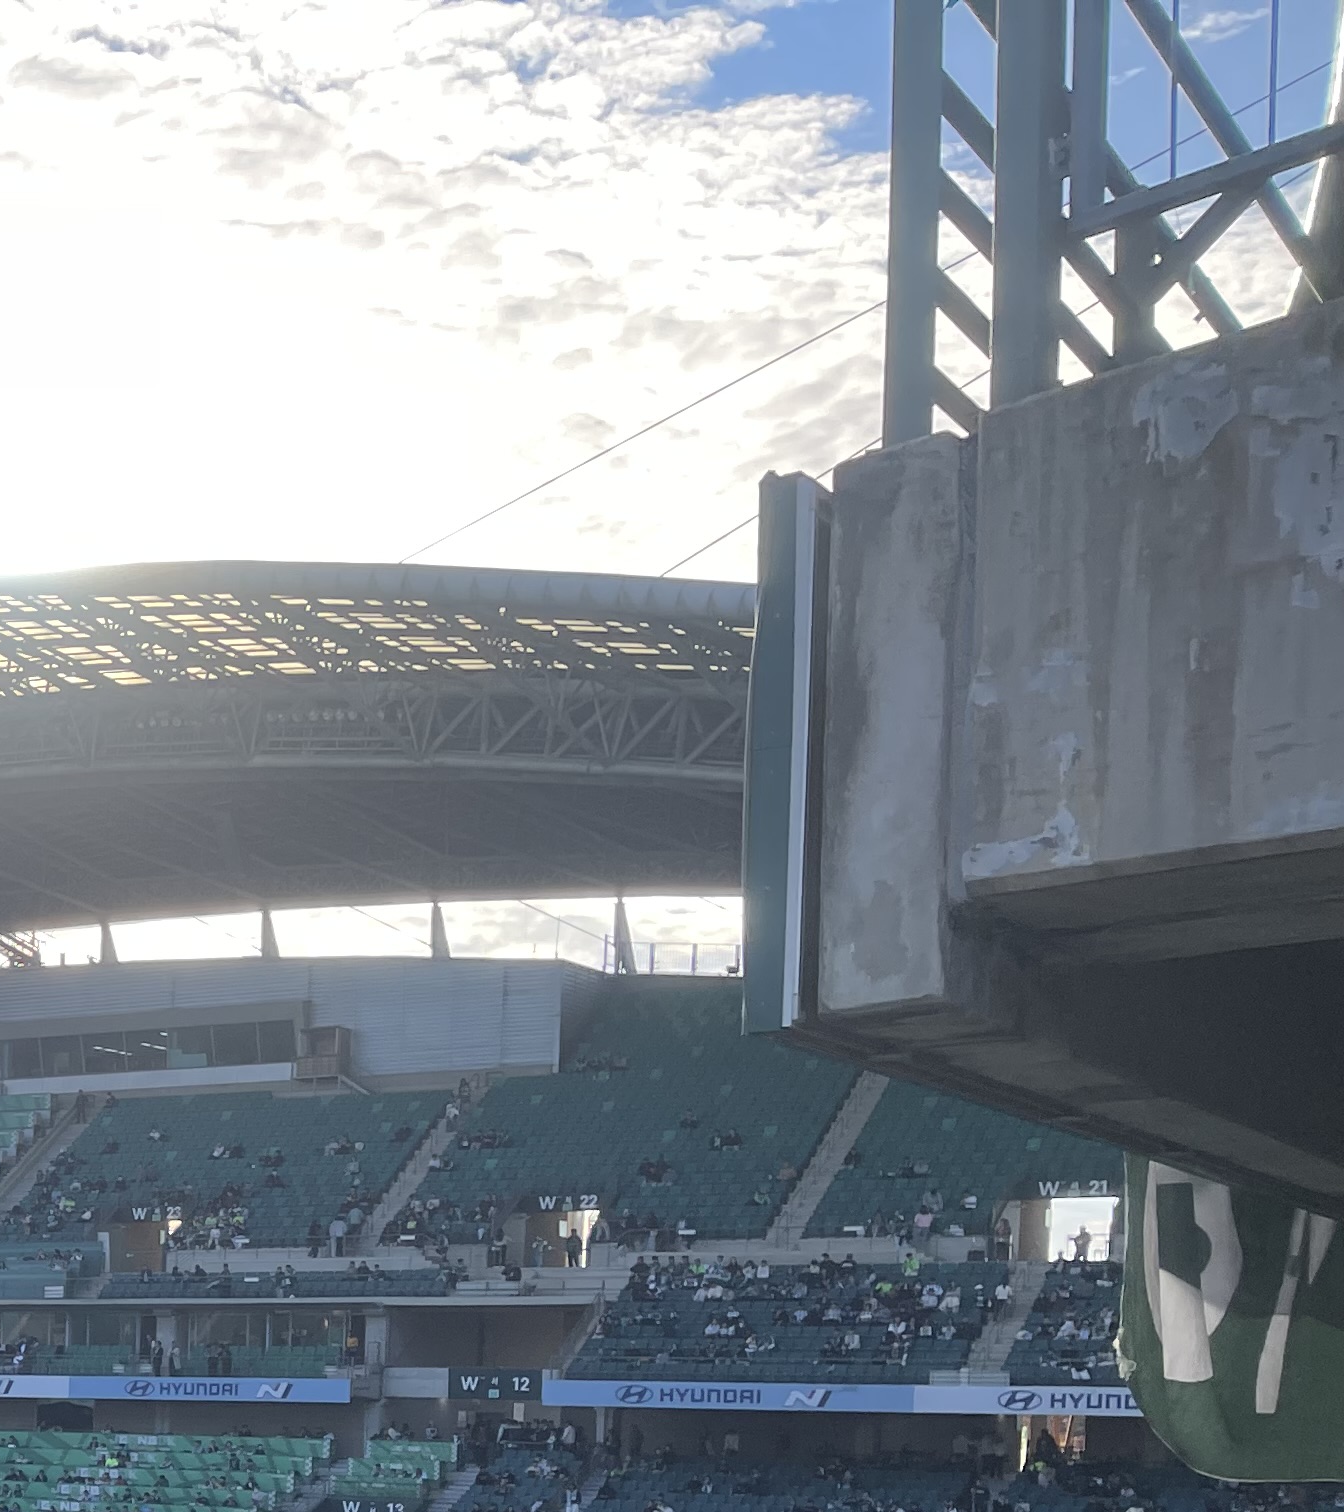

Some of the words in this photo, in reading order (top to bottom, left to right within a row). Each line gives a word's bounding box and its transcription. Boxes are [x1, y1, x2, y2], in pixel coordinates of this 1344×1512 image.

[1039, 1180, 1060, 1195] W
[1089, 1179, 1108, 1194] 21
[538, 1195, 555, 1210] W
[579, 1194, 597, 1209] 22
[132, 1207, 148, 1220] W
[166, 1206, 181, 1219] 23
[159, 1383, 239, 1396] HYUNDAI
[461, 1376, 479, 1391] W
[513, 1377, 530, 1391] 12
[660, 1388, 762, 1404] HYUNDAI
[1050, 1393, 1139, 1410] HYUND
